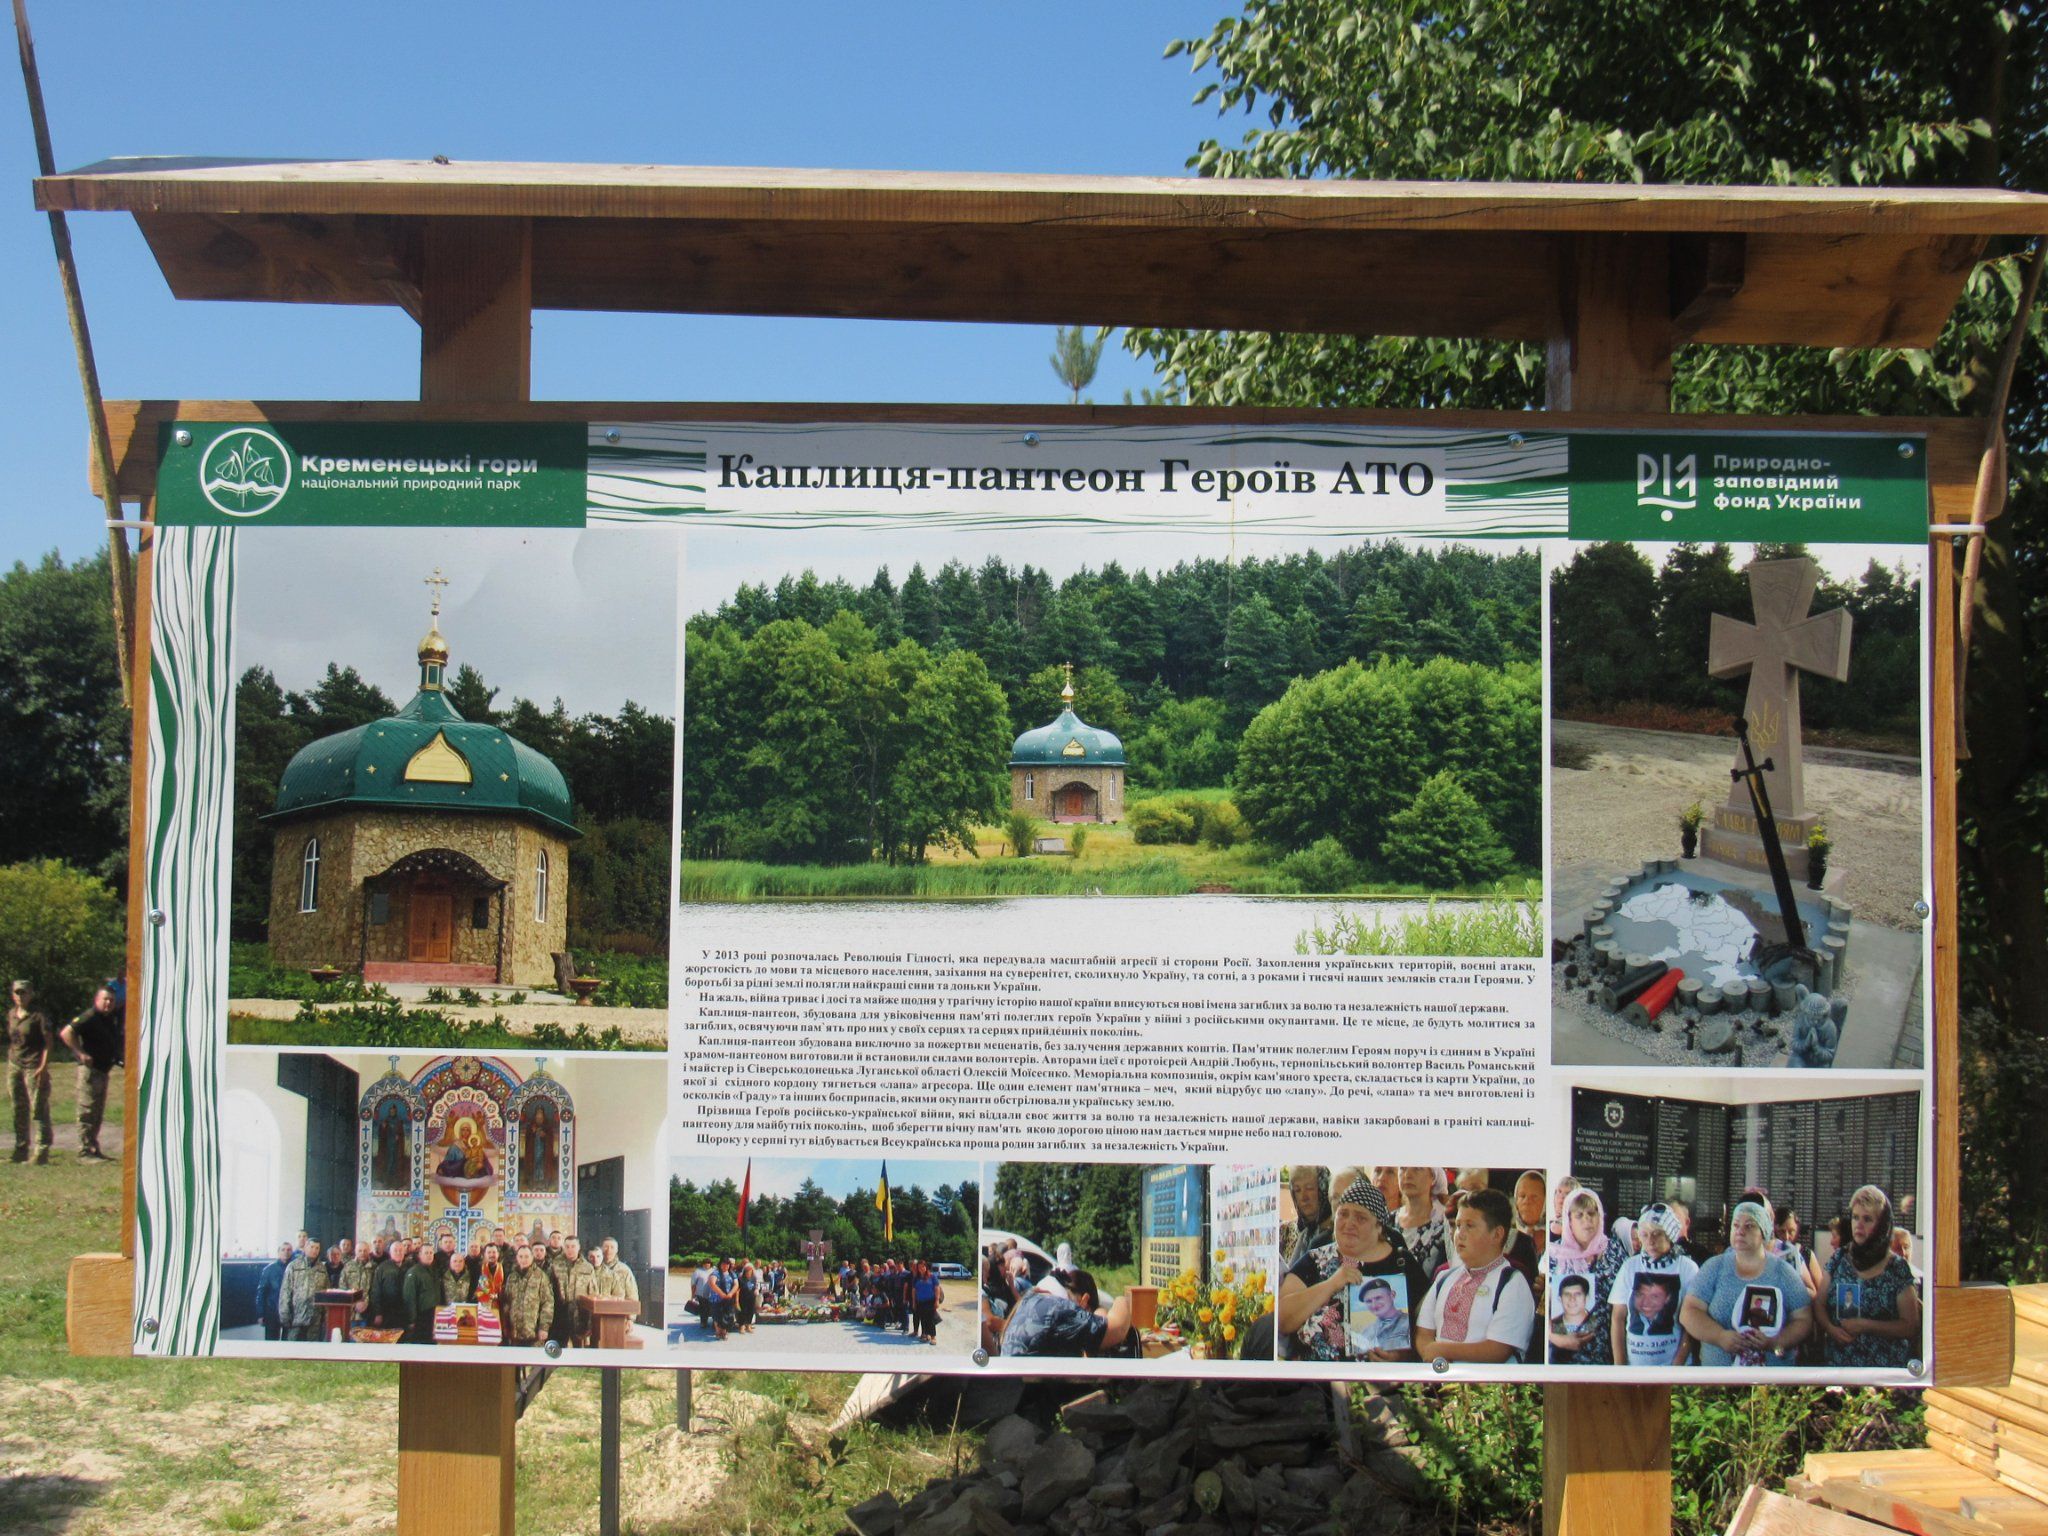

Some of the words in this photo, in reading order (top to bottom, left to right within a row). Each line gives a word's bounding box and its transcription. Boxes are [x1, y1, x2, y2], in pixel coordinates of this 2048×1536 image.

[302, 454, 470, 475] Кременецькі
[478, 458, 538, 476] гори
[1714, 454, 1831, 471] Природно-
[302, 476, 398, 490] національний
[404, 477, 482, 490] природний
[487, 480, 520, 490] парк
[717, 454, 1145, 495] Каплиця-пантеон
[1160, 458, 1317, 502] Героїв
[1329, 460, 1434, 496] АТО
[1714, 474, 1840, 492] заповідний
[1714, 492, 1772, 510] фонд
[1776, 494, 1862, 511] України
[702, 949, 711, 960] У
[715, 950, 739, 960] 2013
[743, 950, 767, 963] році
[771, 953, 839, 964] розпочалась
[844, 952, 902, 963] Революція
[907, 953, 955, 965] Гідності,
[959, 956, 979, 964] яка
[983, 956, 1046, 968] передувала
[1050, 954, 1116, 966] масштабній
[1121, 956, 1158, 969] агресії
[1161, 956, 1170, 966] зі
[1174, 959, 1219, 970] сторони
[1223, 957, 1252, 968] Росії.
[1256, 957, 1321, 968] Захоплення
[1325, 959, 1394, 972] українських
[1398, 960, 1456, 973] територій,
[1461, 960, 1496, 971] воєнні
[1500, 963, 1536, 973] атаки,
[685, 977, 732, 990] боротьбі
[733, 980, 744, 988] за
[746, 977, 773, 990] рідні
[775, 978, 804, 989] землі
[805, 981, 851, 990] полягли
[852, 979, 906, 992] найкращі
[908, 982, 935, 990] сини
[950, 983, 991, 992] доньки
[993, 981, 1041, 994] України.
[699, 1007, 800, 1019] Каплиця-пантеон,
[803, 1008, 857, 1022] збудована
[860, 1012, 880, 1021] для
[883, 1010, 956, 1023] увіковічення
[1004, 1014, 1054, 1023] полеглих
[1058, 1012, 1092, 1025] героїв
[1096, 1012, 1141, 1026] України
[1144, 1016, 1151, 1026] у
[1154, 1013, 1182, 1024] війні
[1194, 1014, 1265, 1027] російськими
[1268, 1018, 1339, 1028] окупантами.
[1343, 1016, 1358, 1028] Це
[1361, 1018, 1373, 1027] те
[1376, 1016, 1409, 1028] місце,
[1412, 1019, 1425, 1028] де
[1427, 1017, 1464, 1030] будуть
[1467, 1020, 1520, 1029] молитися
[1525, 1021, 1535, 1029] за
[698, 1035, 796, 1047] Каплиця-пантеон
[799, 1037, 853, 1050] збудована
[855, 1040, 912, 1048] виключно
[928, 1041, 981, 1052] пожертви
[984, 1040, 1042, 1052] меценатів,
[1044, 1040, 1061, 1051] без
[1063, 1043, 1121, 1054] залучення
[1123, 1044, 1184, 1055] державних
[1187, 1043, 1229, 1053] коштів.
[1296, 1046, 1349, 1055] полеглим
[1351, 1045, 1391, 1058] Героям
[1394, 1048, 1427, 1059] поруч
[1429, 1046, 1438, 1056] із
[1440, 1049, 1481, 1057] єдиним
[1493, 1047, 1535, 1060] Україні
[684, 1051, 788, 1062] храмом-пантеоном
[790, 1053, 854, 1062] виготовили
[856, 1051, 863, 1062] й
[865, 1054, 930, 1063] встановили
[932, 1055, 973, 1063] силами
[976, 1053, 1039, 1067] волонтерів.
[1042, 1054, 1097, 1068] Авторами
[1099, 1055, 1119, 1066] ідеї
[1120, 1058, 1126, 1066] є
[1128, 1056, 1187, 1069] протоієрей
[1190, 1056, 1229, 1069] Андрій
[1280, 1058, 1369, 1072] тернопільський
[1372, 1061, 1423, 1072] волонтер
[1425, 1059, 1465, 1070] Василь
[1468, 1060, 1535, 1071] Романський
[683, 1062, 687, 1072] і
[689, 1063, 734, 1076] майстер
[736, 1063, 745, 1074] із
[856, 1065, 919, 1078] Луганської
[921, 1066, 961, 1077] області
[963, 1066, 1008, 1078] Олексій
[1074, 1068, 1148, 1082] Меморіальна
[1150, 1069, 1217, 1082] композиція,
[1219, 1070, 1252, 1084] окрім
[1313, 1074, 1352, 1085] хреста,
[1354, 1075, 1423, 1084] складається
[1425, 1073, 1434, 1084] із
[1436, 1076, 1469, 1086] карти
[1472, 1074, 1521, 1087] України,
[1522, 1077, 1535, 1086] до
[697, 1105, 751, 1118] Прізвища
[755, 1105, 790, 1119] Героїв
[794, 1107, 918, 1121] російсько-української
[920, 1108, 955, 1120] війни,
[958, 1109, 976, 1119] які
[979, 1109, 1022, 1121] віддали
[1025, 1112, 1049, 1121] своє
[1052, 1113, 1087, 1121] життя
[1106, 1114, 1135, 1122] волю
[1138, 1114, 1151, 1122] та
[1154, 1112, 1228, 1123] незалежність
[1232, 1114, 1266, 1124] нашої
[1268, 1116, 1319, 1127] держави,
[1323, 1114, 1360, 1125] навіки
[1364, 1115, 1430, 1128] закарбовані
[1444, 1116, 1482, 1129] граніті
[1486, 1116, 1535, 1128] каплиці-
[697, 1133, 742, 1147] Щороку
[744, 1136, 750, 1147] у
[751, 1134, 787, 1147] серпні
[789, 1137, 807, 1148] тут
[809, 1135, 879, 1149] відбувається
[881, 1137, 961, 1150] Всеукраїнська
[963, 1140, 1000, 1151] проща
[1002, 1141, 1035, 1151] родин
[1036, 1139, 1086, 1150] загиблих
[1091, 1142, 1102, 1150] за
[1104, 1140, 1178, 1151] незалежність
[1180, 1141, 1228, 1154] України.
